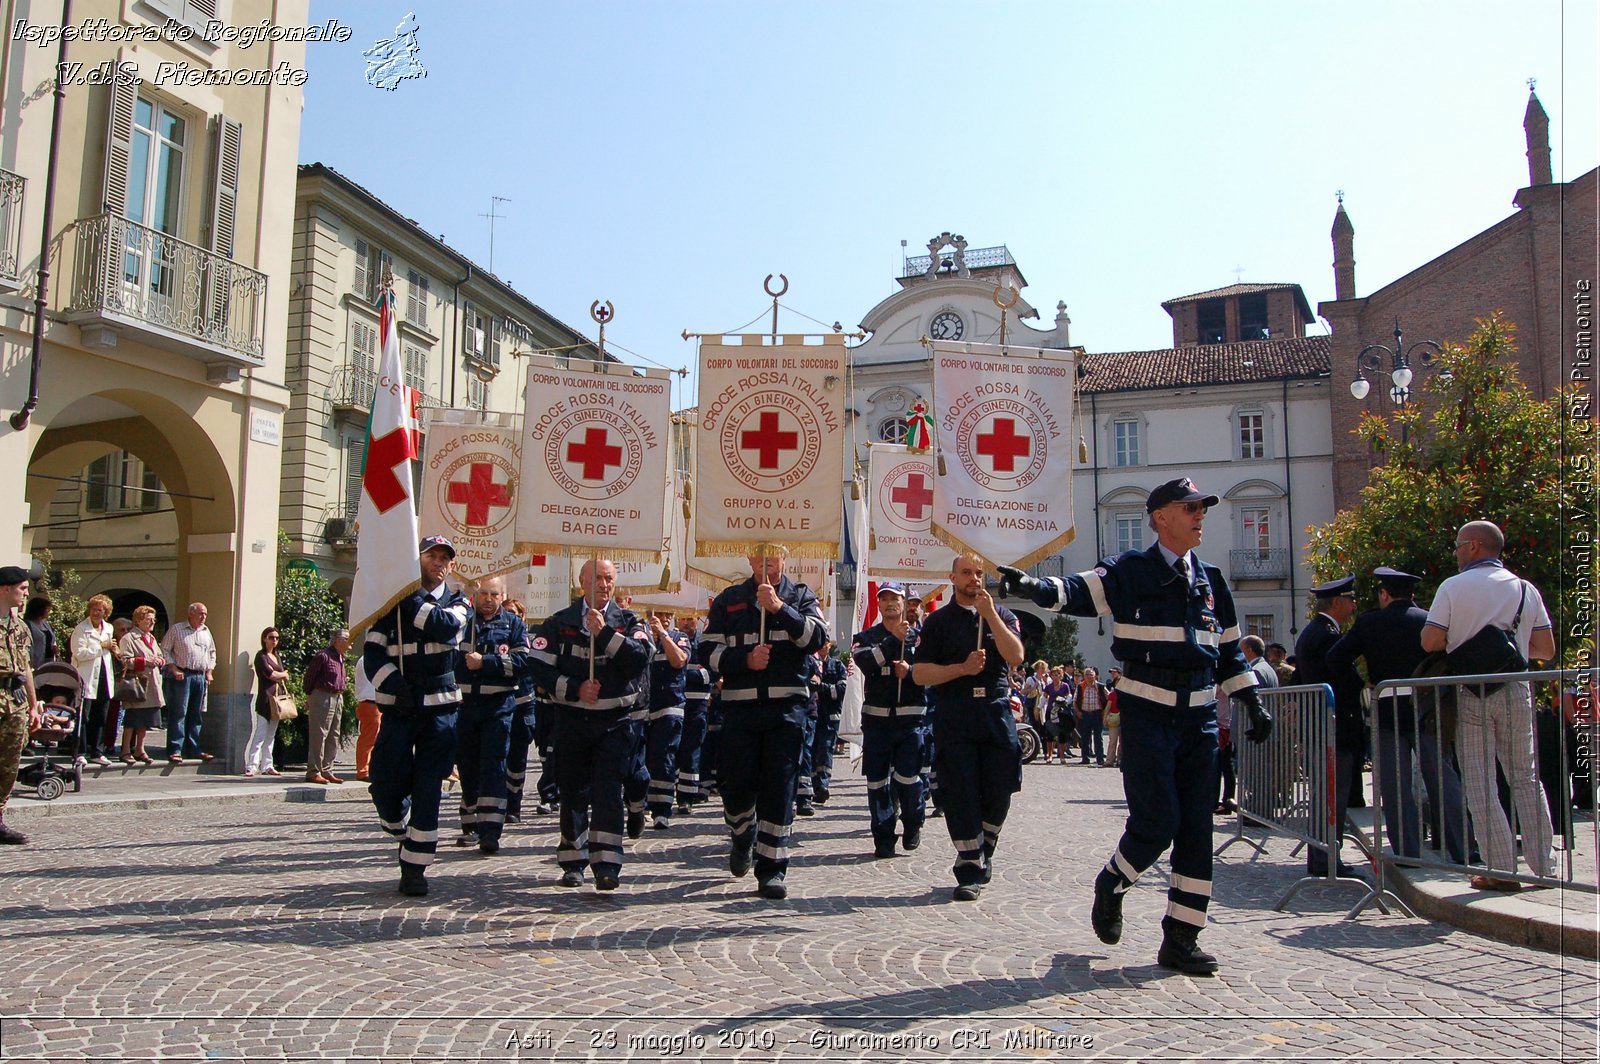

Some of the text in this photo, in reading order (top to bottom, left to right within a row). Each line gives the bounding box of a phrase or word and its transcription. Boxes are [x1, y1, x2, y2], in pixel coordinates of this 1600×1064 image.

[707, 359, 838, 370] CORPO VOLONTARI DEL SOCCORSO
[940, 358, 1066, 377] CORPO VOLONTARI DEL SOCCORSO
[533, 374, 664, 394] CORPO VOLONTARI DEL SOCCORSO
[702, 372, 838, 434] CROCE ROSSA ITALIANA
[942, 382, 1060, 440] CROCE ROSSA ITALIANA
[532, 393, 658, 450] CROCE ROSSA ITALIANA
[724, 394, 818, 487] CONVENZIONE DI GINEVRA 22 AGOSTO 1864
[958, 401, 1046, 487] CONVENZIONE DI GINEVRA 22 AGOSTO 1864
[430, 438, 460, 470] CROCE
[461, 433, 500, 444] ROSSA
[548, 410, 640, 496] CONVENZIONE DI GINEVRA 22 AGOSTO 1864
[884, 468, 902, 488] CROCE
[542, 504, 640, 520] DELEGAZIONE DI
[724, 498, 772, 510] GRUPPO
[957, 498, 1048, 512] DELEGAZIONE DI
[562, 522, 618, 536] BARGE
[726, 516, 810, 530] MONALE
[946, 513, 1058, 532] PIOVA' MASSAIA
[452, 536, 498, 548] COMITATO
[878, 536, 918, 544] COMITATO
[910, 548, 918, 556] DI
